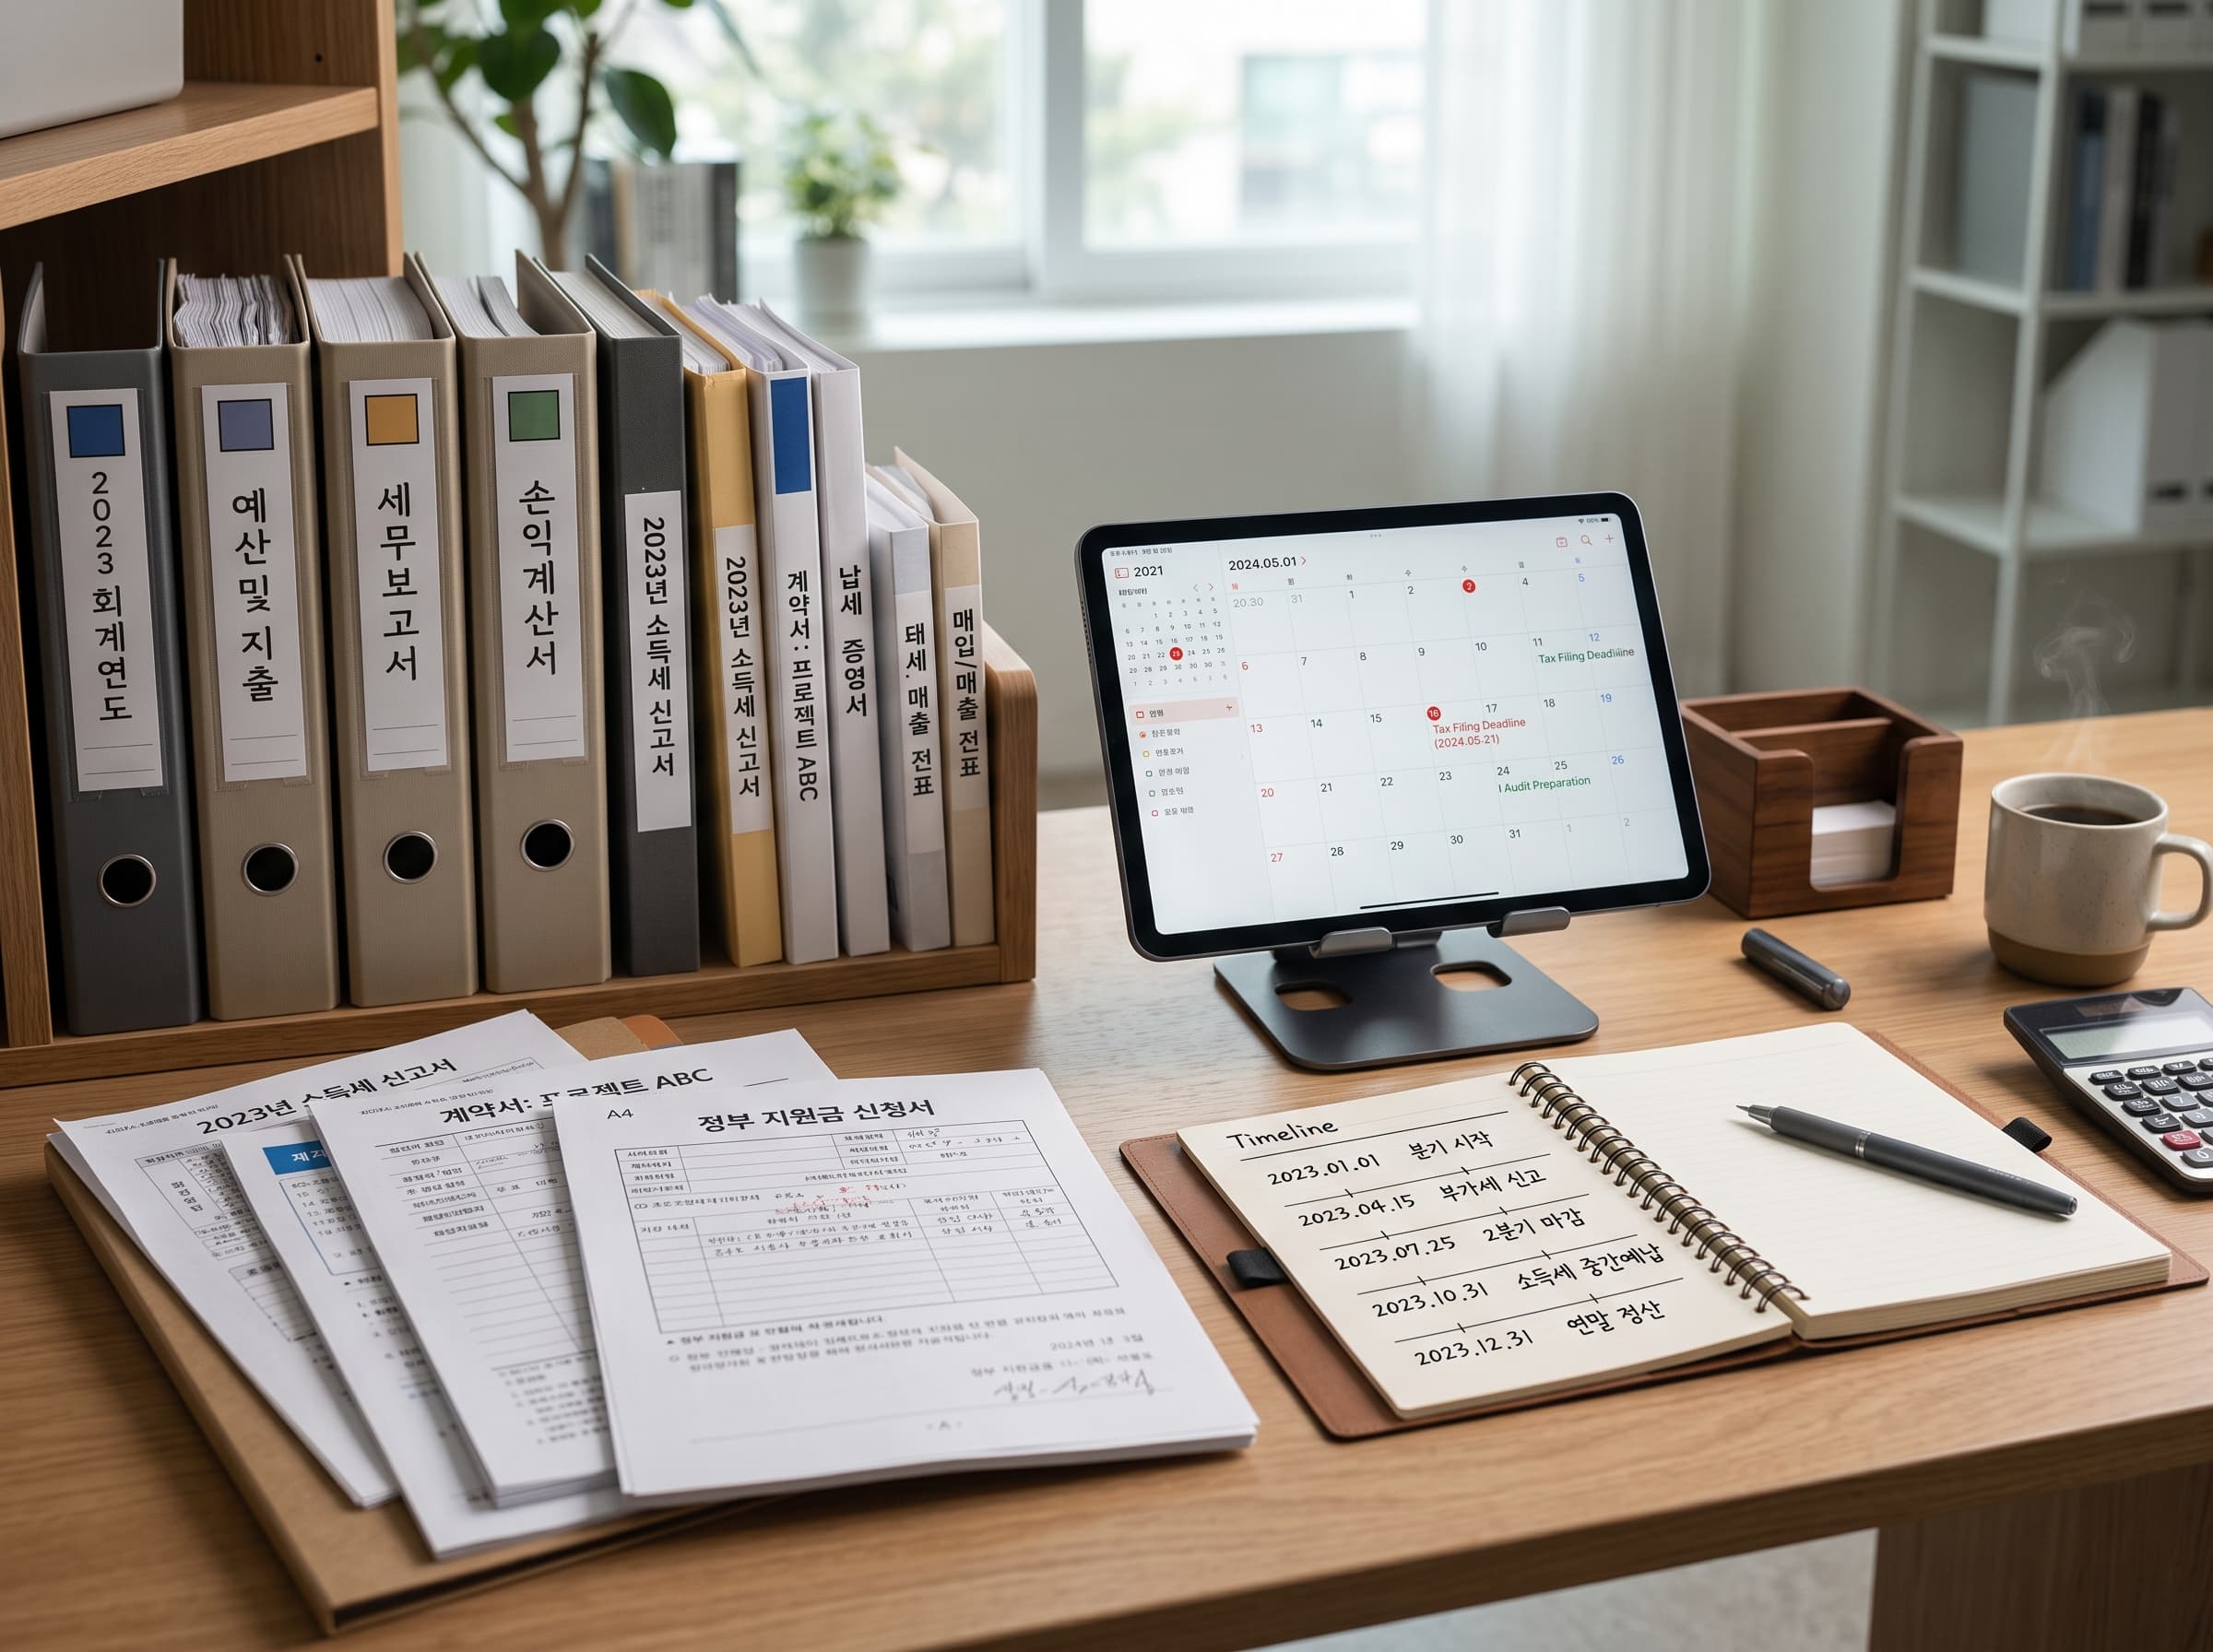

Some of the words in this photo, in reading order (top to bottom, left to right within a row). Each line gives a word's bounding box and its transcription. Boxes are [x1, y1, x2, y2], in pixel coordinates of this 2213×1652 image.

[91, 472, 114, 575] 2023
[378, 482, 420, 681] 세무보고서
[518, 479, 559, 676] 손익계산서
[643, 517, 668, 606] 2023년
[1134, 565, 1163, 577] 2021
[1228, 556, 1296, 571] 2024.05.01
[726, 557, 750, 638] 2023년
[787, 571, 811, 652] 계약서:
[839, 565, 862, 616] 납세
[1291, 595, 1303, 604] 31
[1350, 590, 1355, 598] 1
[1408, 585, 1414, 595] 2
[1522, 578, 1529, 586] 4
[92, 584, 133, 721] 회계연도
[645, 615, 671, 690] 소득세
[953, 608, 978, 721] 매입/매출
[1241, 662, 1249, 671] 6
[1301, 657, 1307, 666] 7
[1360, 652, 1367, 661] 8
[1418, 648, 1425, 656] 9
[1475, 643, 1487, 651] 10
[1533, 638, 1543, 646] 11
[1590, 633, 1600, 643] 12
[1538, 654, 1556, 664] Tax
[1558, 651, 1585, 663] Filing
[730, 649, 755, 717] 소득세
[792, 660, 818, 749] 프로젝트
[649, 700, 675, 777] 신고서
[908, 687, 930, 736] 매출
[1250, 724, 1263, 733] 13
[1311, 719, 1322, 728] 14
[1371, 714, 1382, 723] 15
[1486, 704, 1497, 714] 17
[1544, 699, 1556, 708] 18
[1601, 693, 1612, 702] 19
[1433, 725, 1450, 734] Tax
[1482, 717, 1526, 730] Deadline
[736, 726, 761, 797] 신고서
[798, 757, 818, 802] ABC
[912, 749, 934, 796] 전표
[959, 730, 981, 777] 전표
[1261, 787, 1274, 797] 20
[1320, 783, 1332, 792] 21
[1380, 777, 1393, 786] 22
[1439, 772, 1451, 781] 23
[1497, 766, 1510, 776] 24
[1555, 761, 1568, 770] 25
[1612, 755, 1624, 764] 26
[1504, 782, 1531, 793] Audit
[1533, 776, 1591, 790] Preparation
[1271, 853, 1283, 863] 27
[1331, 847, 1343, 856] 28
[1391, 841, 1403, 851] 29
[1450, 835, 1463, 845] 30
[1509, 830, 1521, 839] 31
[1567, 824, 1572, 832] 1
[1624, 818, 1629, 826] 2
[197, 1100, 297, 1135] 2023년
[382, 1058, 457, 1087] 신고서
[441, 1098, 533, 1124] 계약서:
[657, 1068, 714, 1090] ABC
[607, 1108, 633, 1119] A4
[698, 1114, 755, 1133] 정부
[763, 1105, 844, 1127] 지원금
[853, 1099, 935, 1120] 신청서
[1226, 1122, 1339, 1149] Timeline
[1268, 1154, 1380, 1186] 2023.01.01
[1409, 1140, 1448, 1160] 분기
[1455, 1131, 1493, 1150] 시작
[1298, 1194, 1415, 1226] 2023.04.15
[1439, 1176, 1503, 1202] 부가세
[1507, 1169, 1546, 1188] 신고
[1334, 1235, 1456, 1270] 2023.07.25
[1483, 1219, 1536, 1242] 2분기
[1541, 1209, 1585, 1229] 마감
[1372, 1281, 1488, 1317] 2023.10.31
[1518, 1264, 1577, 1291] 소득세
[1580, 1244, 1664, 1277] 중간예납
[1414, 1329, 1533, 1365] 2023.12.31
[1568, 1310, 1615, 1335] 연말
[1616, 1300, 1665, 1325] 정산
